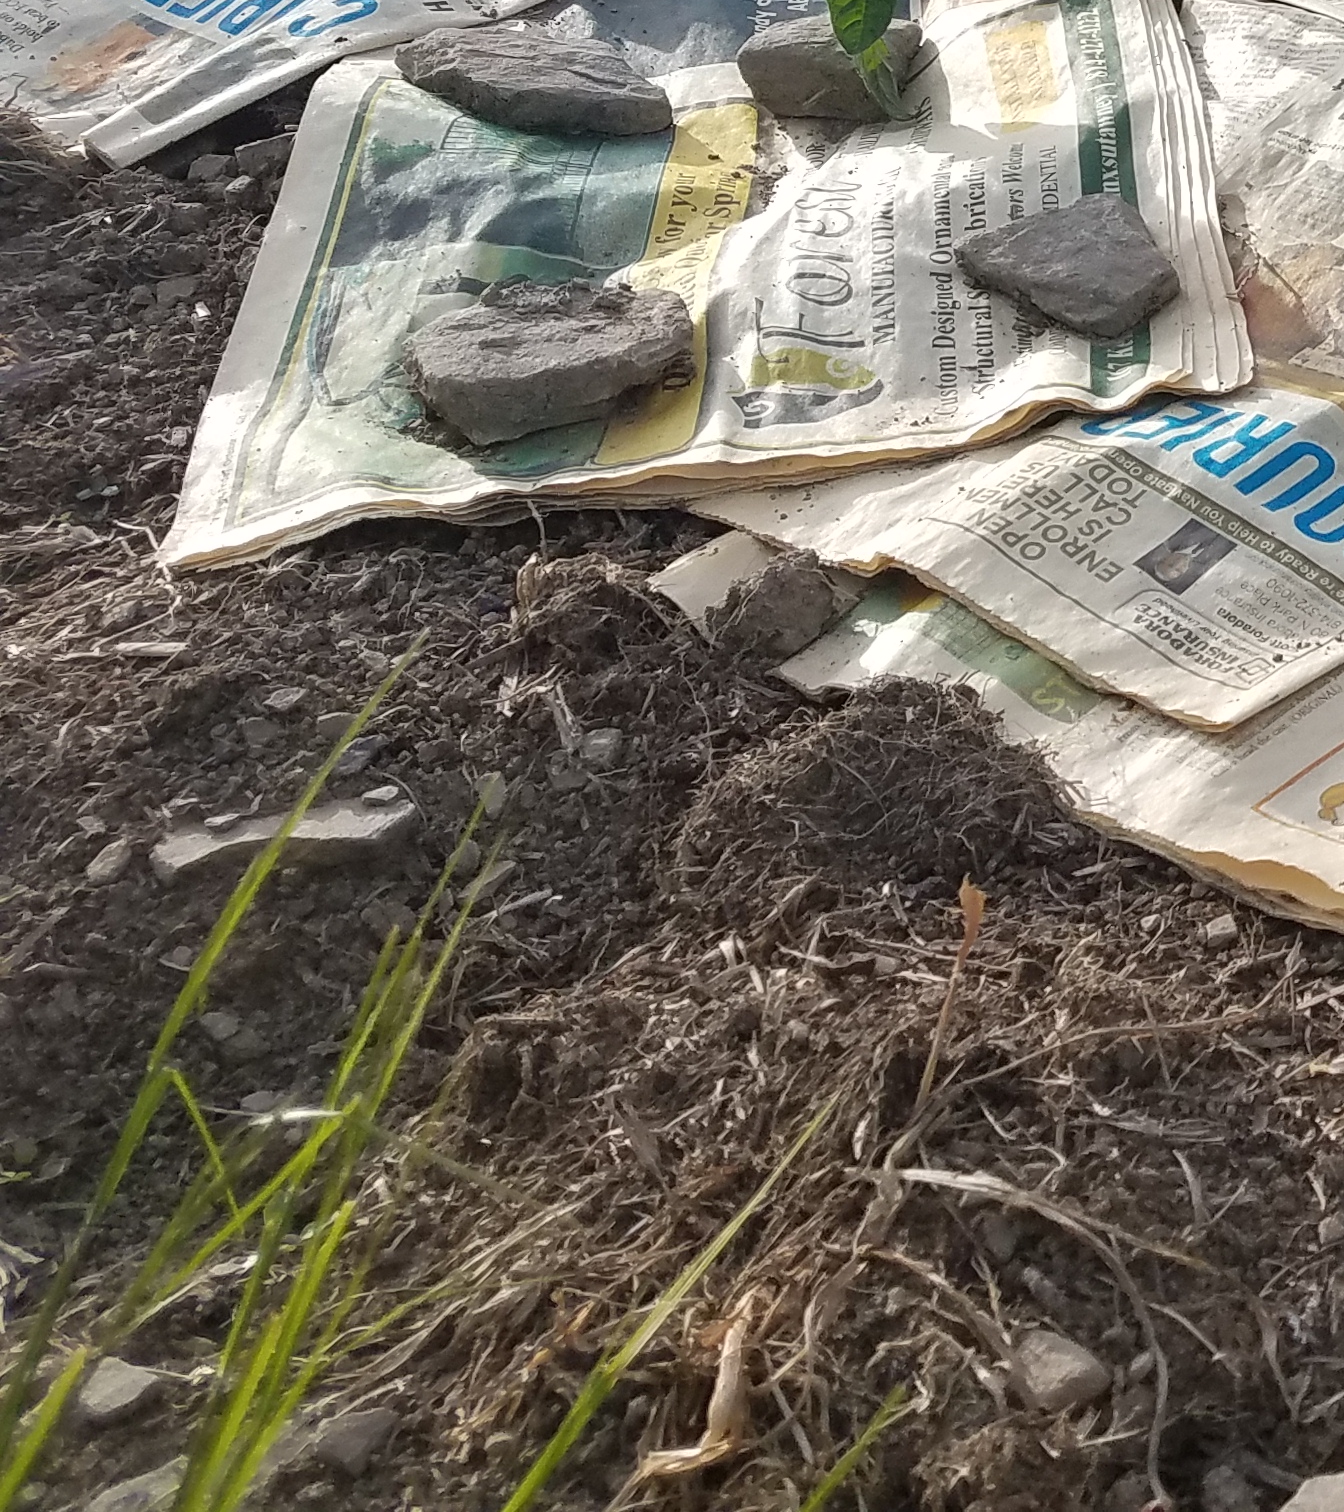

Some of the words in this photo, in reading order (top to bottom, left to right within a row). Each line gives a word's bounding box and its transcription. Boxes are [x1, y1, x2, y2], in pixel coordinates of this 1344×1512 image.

[1096, 94, 1122, 195] nxsutawney
[669, 172, 696, 211] your
[654, 213, 686, 246] for
[930, 172, 954, 264] Ornamental
[929, 271, 957, 349] Designed
[970, 307, 994, 394] Structural
[934, 354, 959, 417] Custom
[1022, 457, 1057, 485] US
[1105, 446, 1143, 478] Open
[996, 469, 1081, 523] HERE!
[1061, 472, 1134, 528] CALL
[1142, 467, 1200, 509] Navigate
[965, 480, 1124, 584] ENROLLMEN
[966, 505, 1048, 563] OPEN
[1078, 516, 1112, 545] IS
[1199, 504, 1225, 527] You
[1225, 514, 1259, 547] Help
[1258, 539, 1274, 555] to
[1273, 545, 1319, 582] Ready
[1238, 579, 1272, 606] Place
[1265, 575, 1341, 630] 814-372-1090
[1269, 601, 1299, 624] Park
[1132, 611, 1233, 676] FORADORA
[1134, 600, 1238, 668] INSURANCE
[1215, 606, 1269, 643] Foradora
